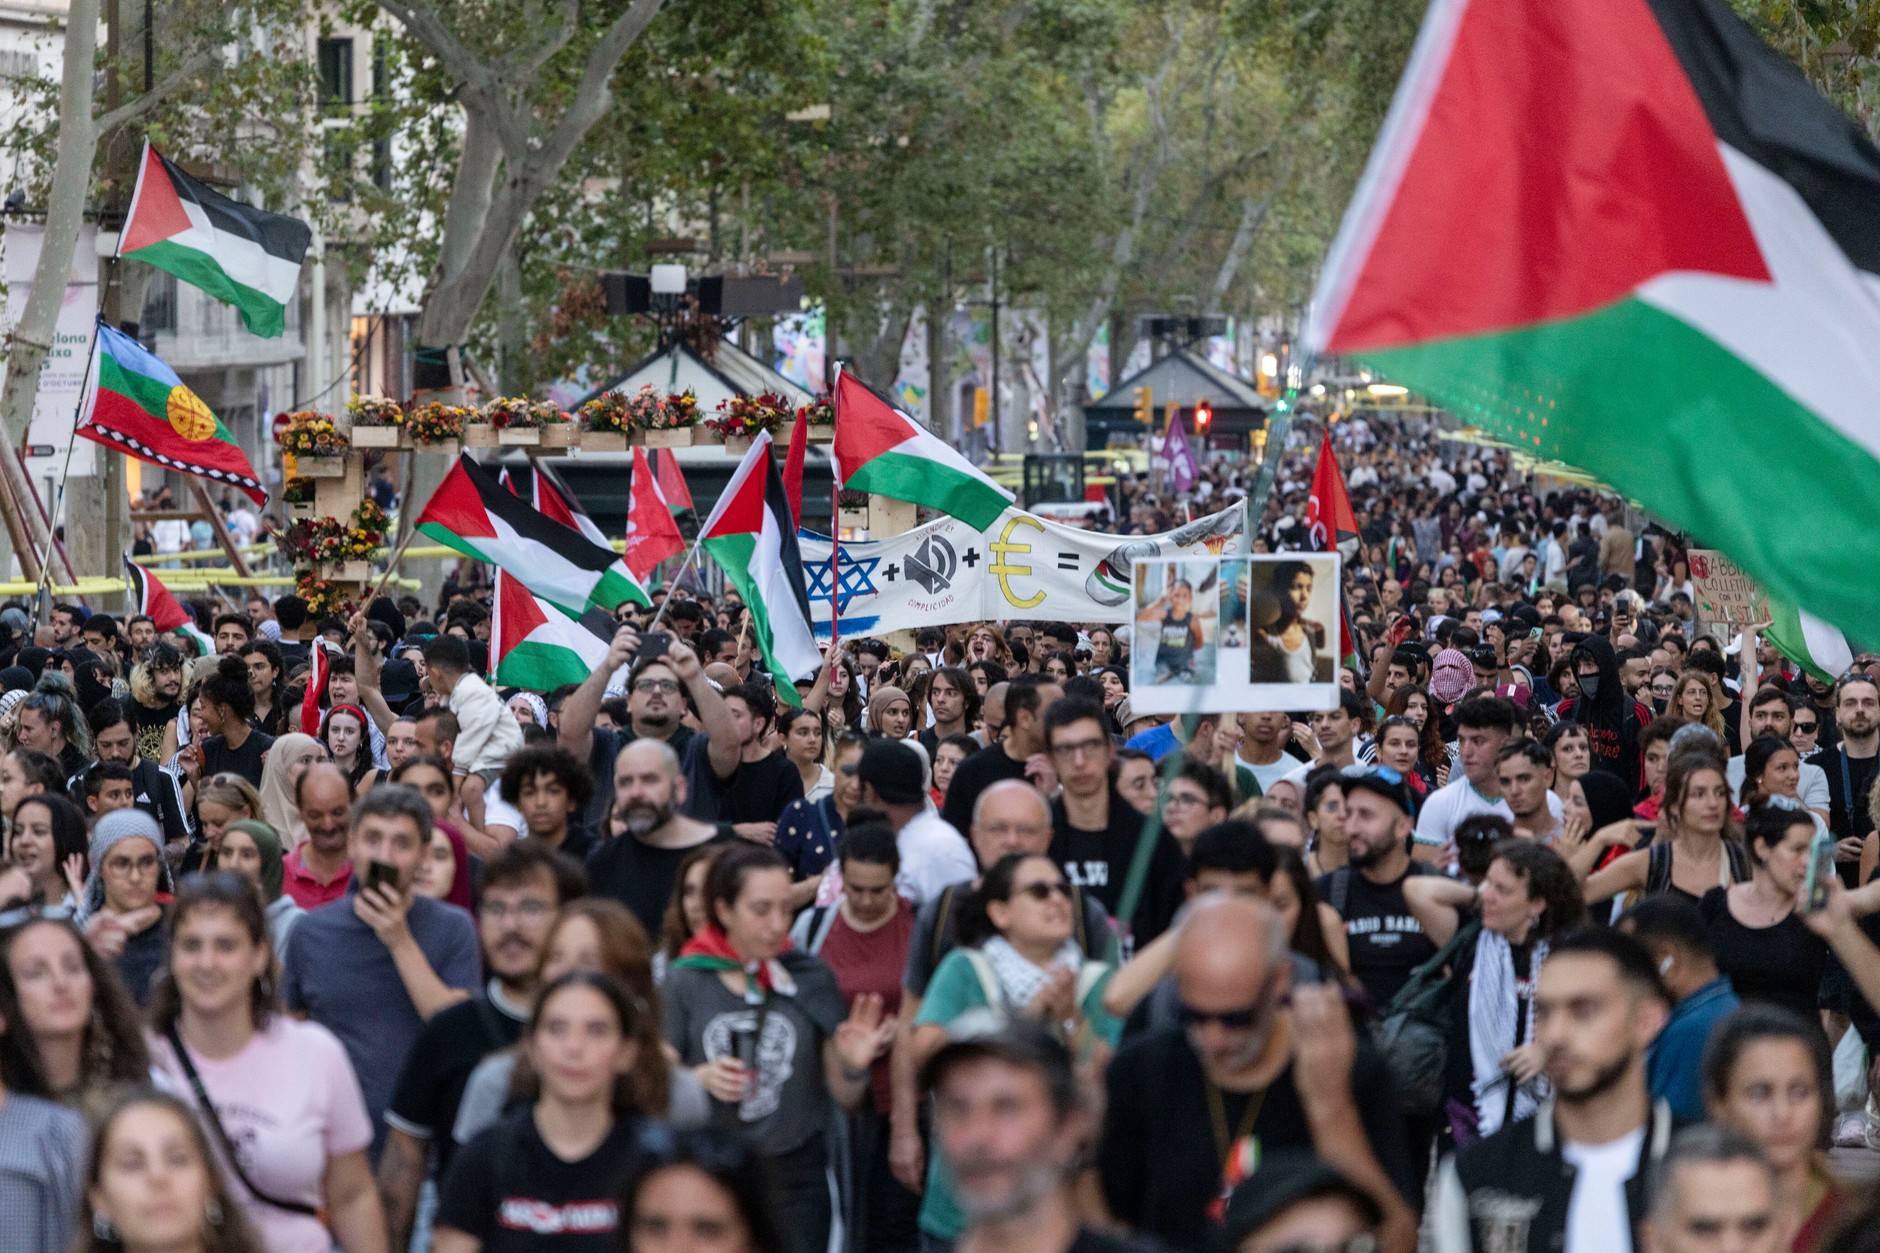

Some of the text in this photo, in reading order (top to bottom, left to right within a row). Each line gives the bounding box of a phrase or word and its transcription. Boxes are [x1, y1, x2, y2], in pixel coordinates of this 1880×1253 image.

[1699, 555, 1746, 577] RABBI
[907, 594, 955, 612] COMPLICIDAD
[1718, 593, 1731, 602] CON
[1710, 602, 1772, 623] PALESTINA
